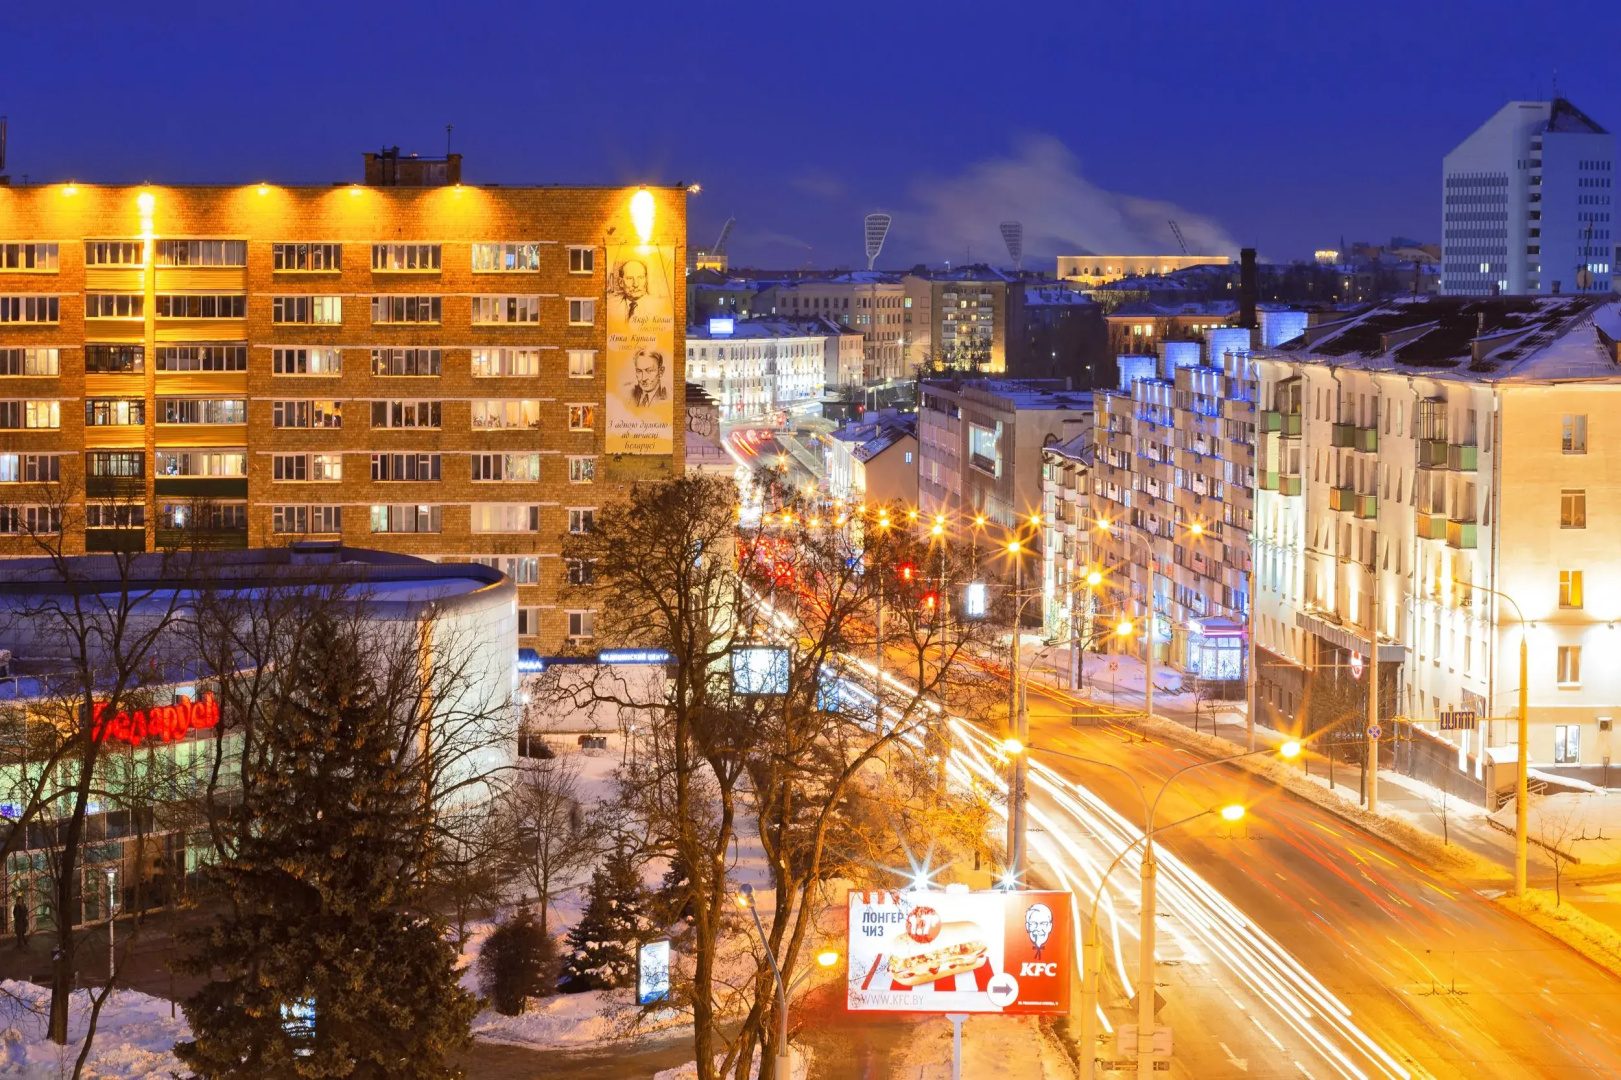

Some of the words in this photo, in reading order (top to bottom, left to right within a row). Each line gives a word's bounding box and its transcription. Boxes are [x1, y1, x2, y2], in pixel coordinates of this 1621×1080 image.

[862, 911, 904, 923] ЛОНГЕР
[862, 925, 884, 937] ЧИЗ
[1019, 962, 1058, 977] KFC
